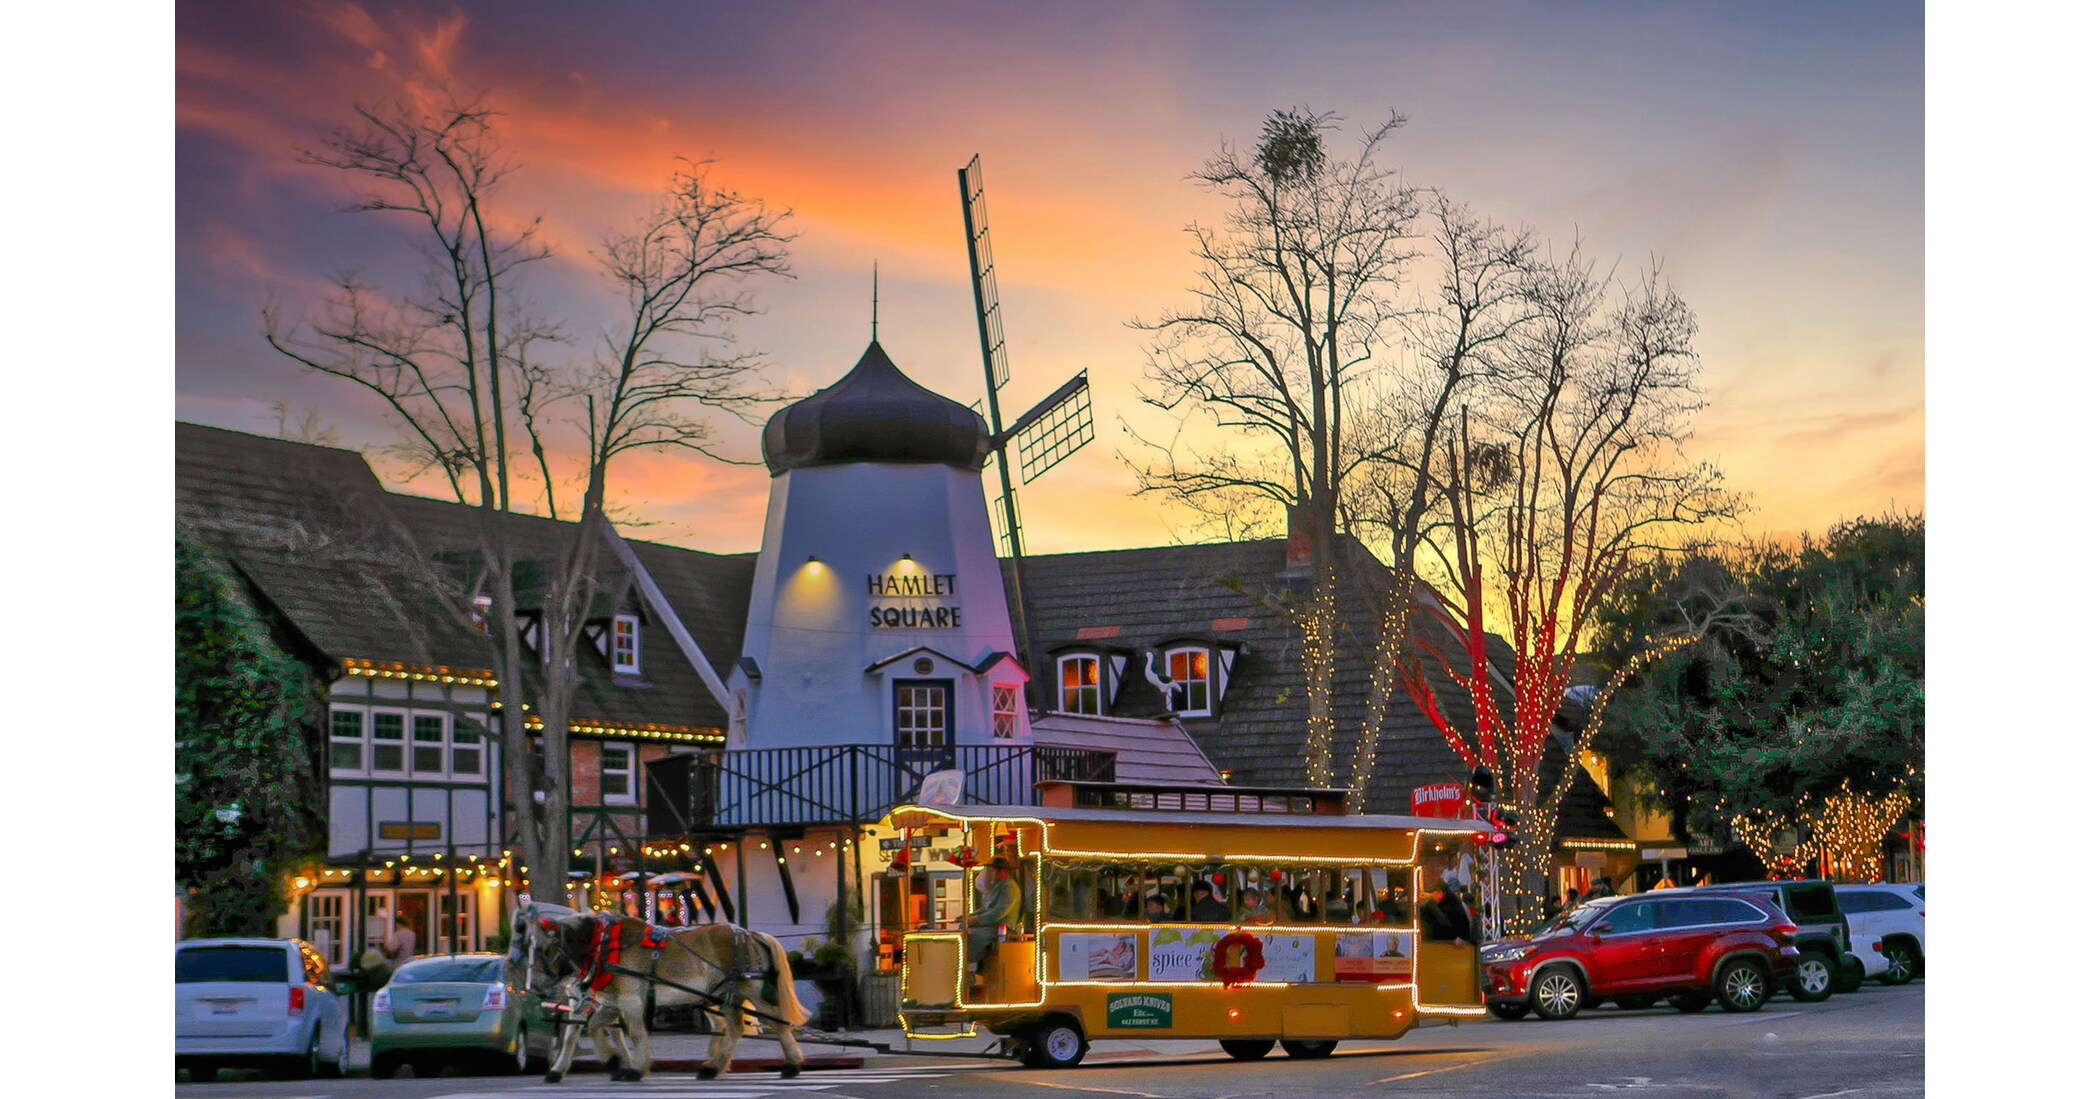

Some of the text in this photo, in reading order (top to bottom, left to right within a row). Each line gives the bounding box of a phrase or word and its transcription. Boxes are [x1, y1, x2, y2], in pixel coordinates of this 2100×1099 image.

[867, 574, 956, 595] HAMLET
[870, 606, 962, 628] SQUARE
[1413, 785, 1461, 805] Birkholm's
[1152, 950, 1193, 975] spice
[1110, 996, 1170, 1012] SOLVANG KNIVES
